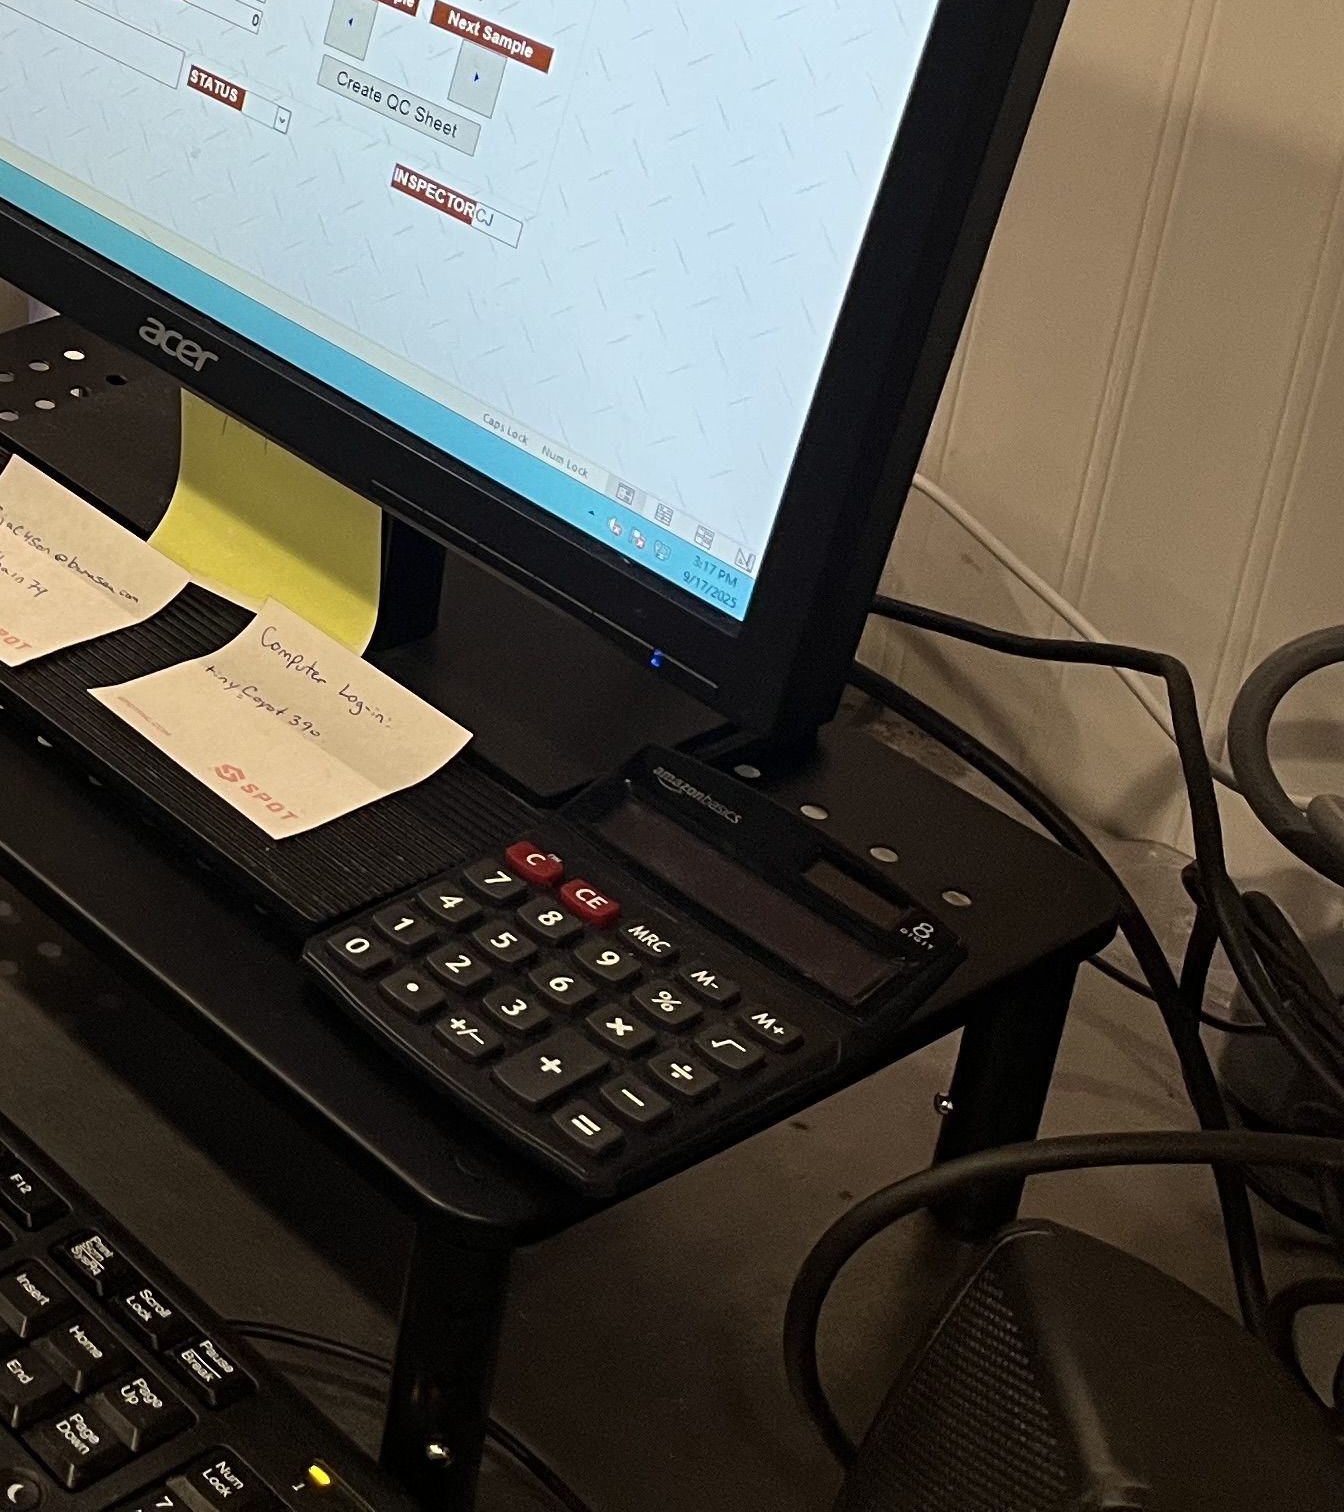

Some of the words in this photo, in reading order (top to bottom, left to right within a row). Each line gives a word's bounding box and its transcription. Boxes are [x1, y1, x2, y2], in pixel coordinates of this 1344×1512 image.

[190, 68, 239, 103] STATUS
[337, 71, 382, 104] Create
[386, 92, 412, 116] QC
[414, 104, 457, 139] Sheet
[394, 167, 476, 218] INSPECTOR
[476, 202, 495, 227] CJ
[139, 317, 220, 372] acer
[262, 626, 326, 684] Computer
[241, 784, 298, 820] SPOT
[653, 767, 741, 824] amazonbasics
[576, 889, 608, 910] CE
[629, 925, 671, 953] MRC
[10, 1173, 32, 1194] F12
[17, 1273, 50, 1305] Insert
[69, 1325, 102, 1359] Home
[6, 1359, 34, 1385] End
[121, 1386, 140, 1405] Up
[133, 1378, 163, 1409] Page
